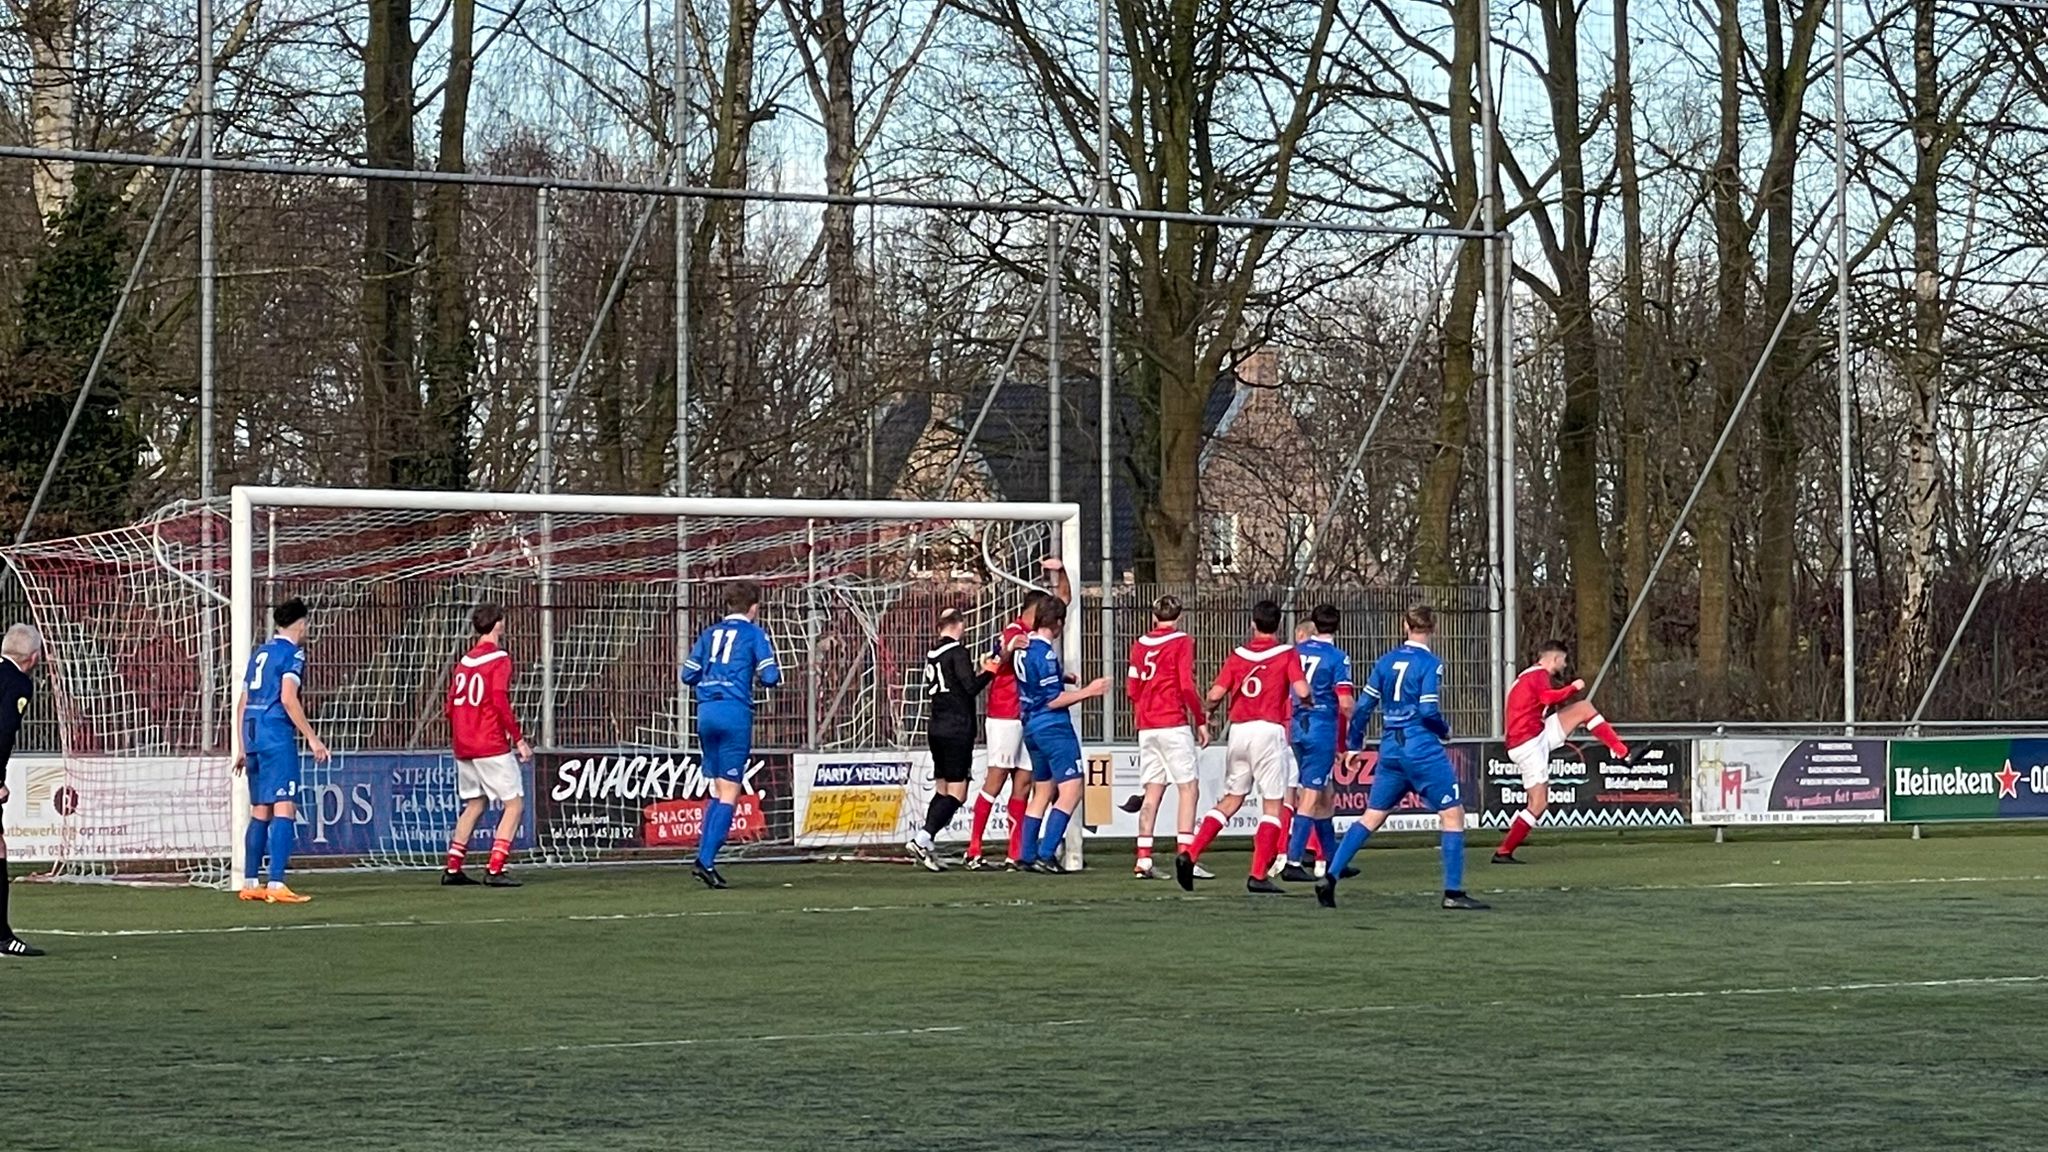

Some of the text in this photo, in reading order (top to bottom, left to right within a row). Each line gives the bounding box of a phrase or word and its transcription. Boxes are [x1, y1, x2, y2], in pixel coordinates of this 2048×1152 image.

[709, 629, 738, 664] 11
[249, 651, 269, 690] 3
[1141, 650, 1160, 681] 5
[1241, 664, 1267, 698] 6
[453, 672, 485, 707] 20
[1392, 661, 1410, 702] 7
[816, 765, 909, 784] PARTY VERHUUR
[1087, 760, 1109, 786] H
[1894, 766, 1994, 796] Heineken
[5, 823, 76, 840] utbewerking
[80, 827, 95, 840] op
[658, 826, 667, 838] &
